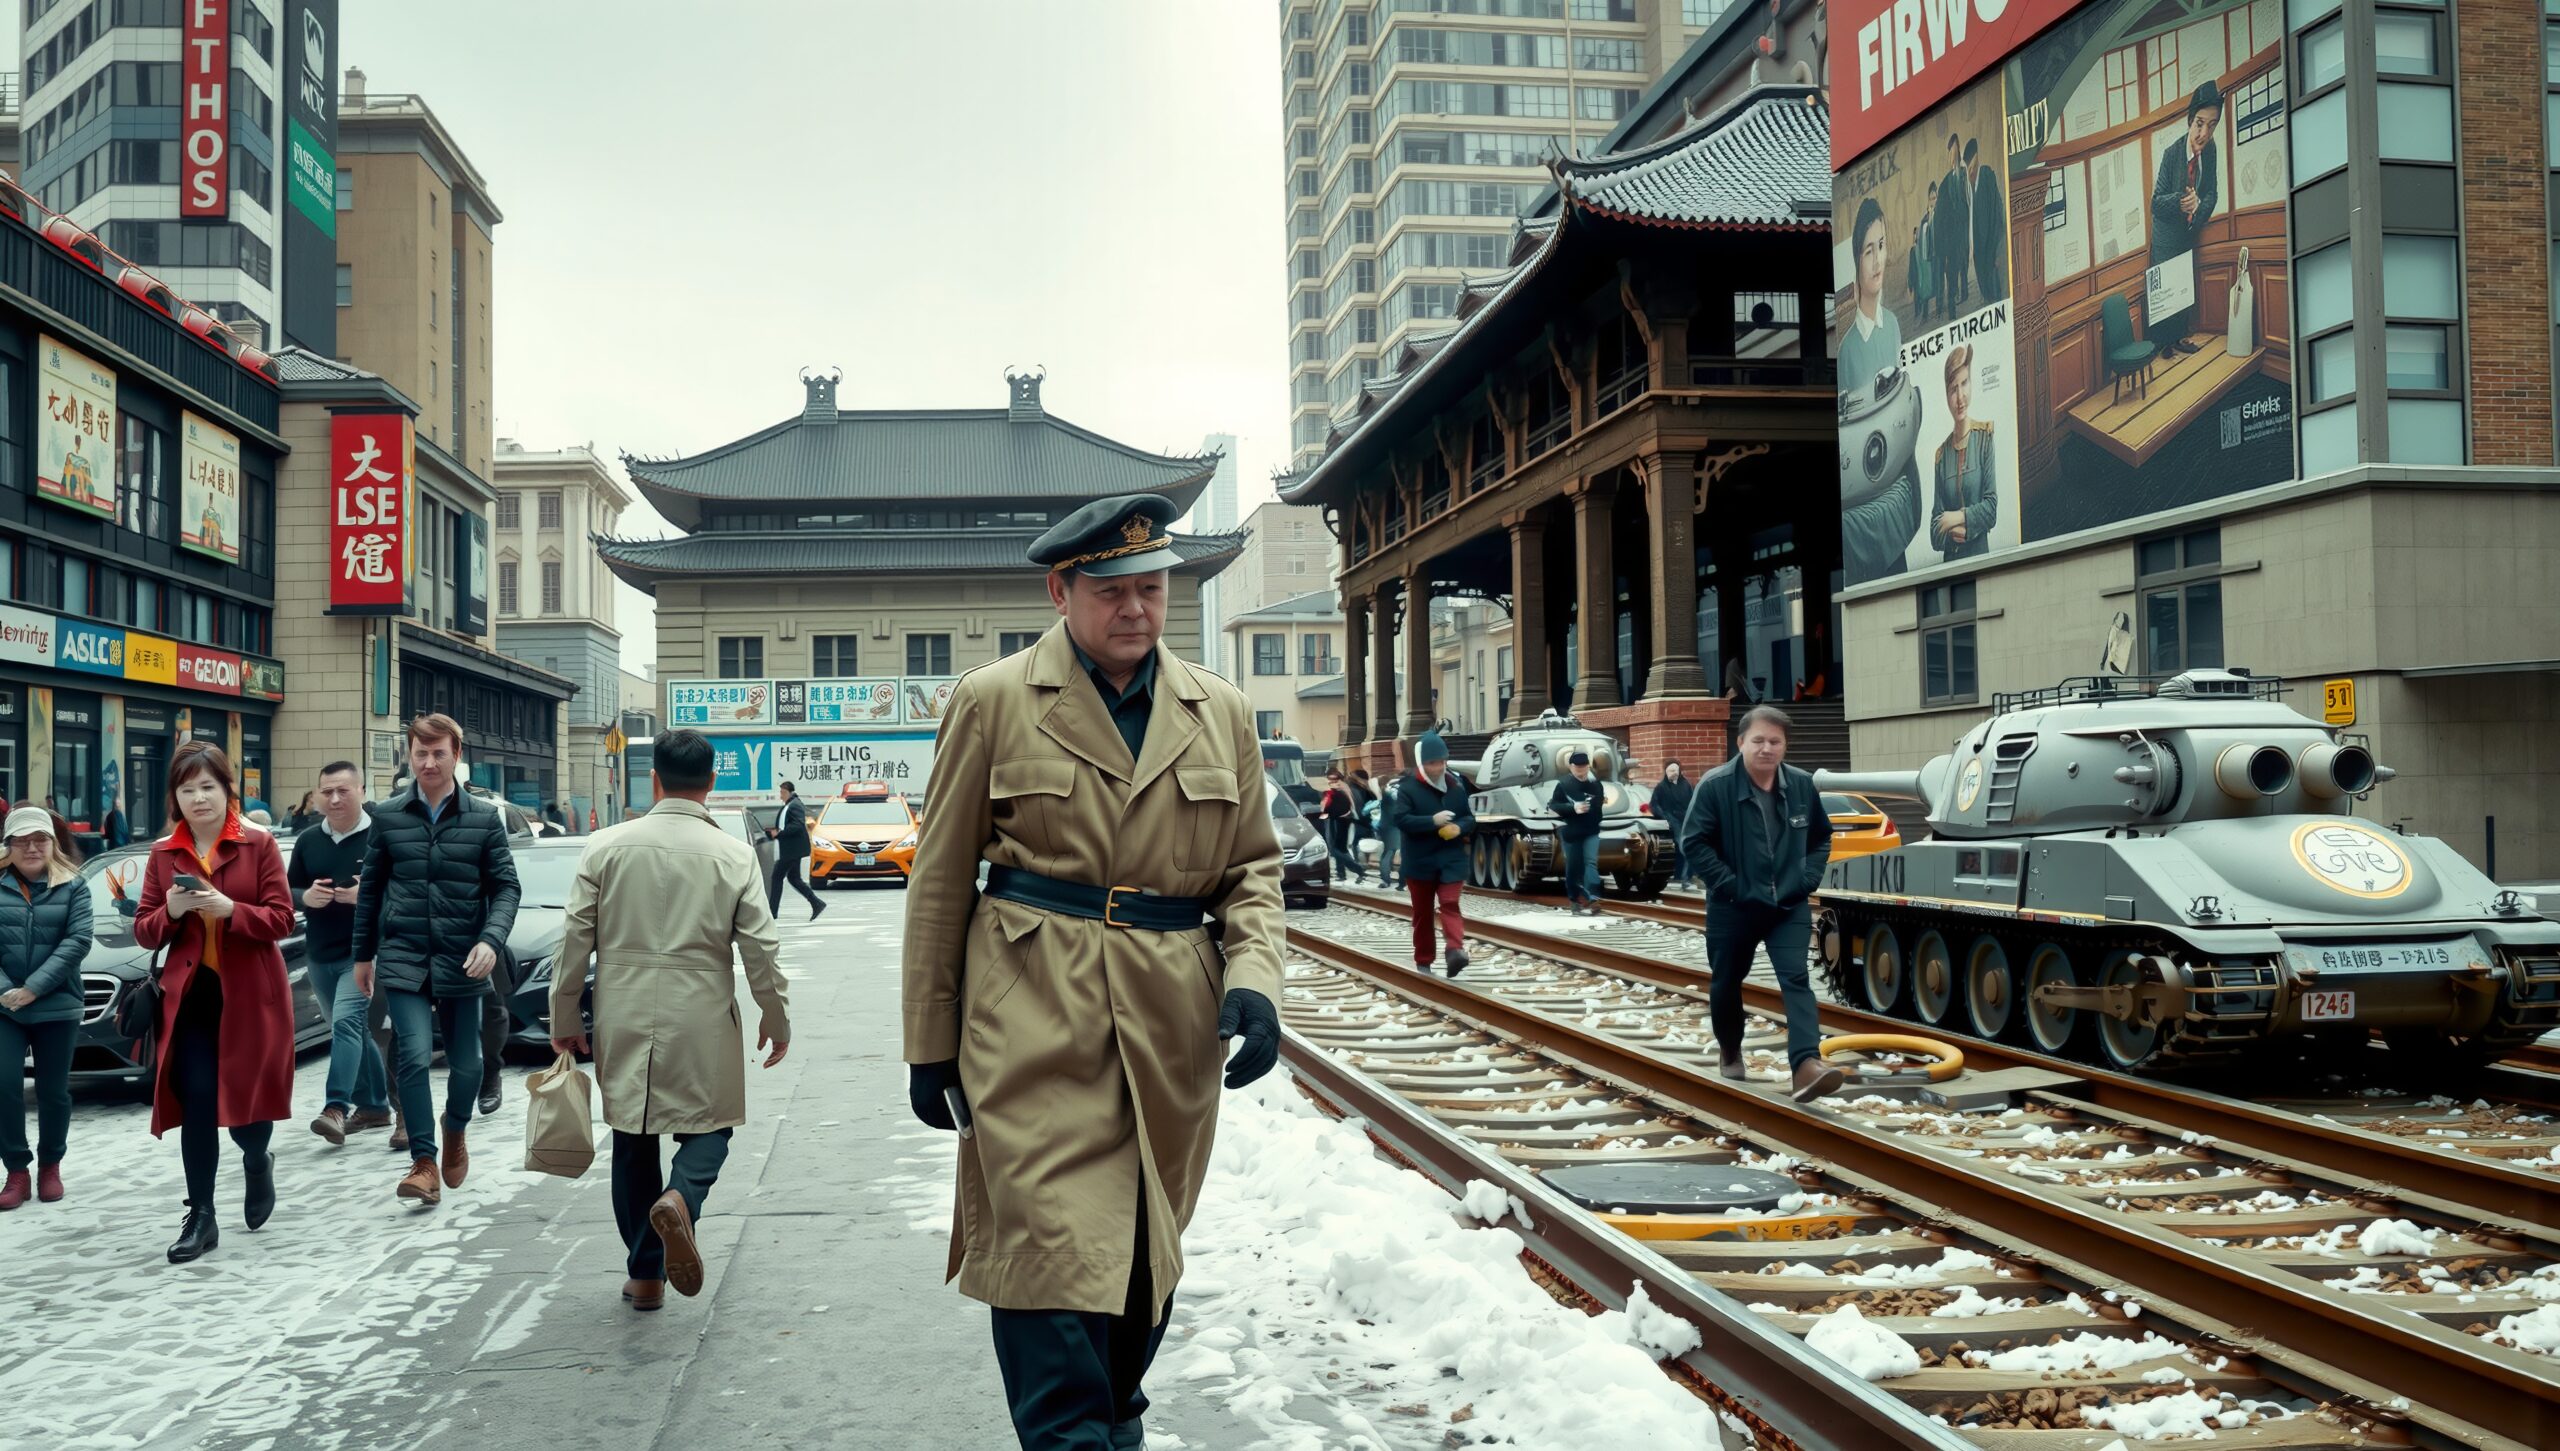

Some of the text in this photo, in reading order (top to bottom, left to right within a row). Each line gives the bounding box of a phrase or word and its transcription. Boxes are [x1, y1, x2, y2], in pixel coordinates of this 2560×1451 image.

[344, 434, 395, 482] 大
[337, 486, 397, 526] LSE
[828, 745, 871, 762] LING
